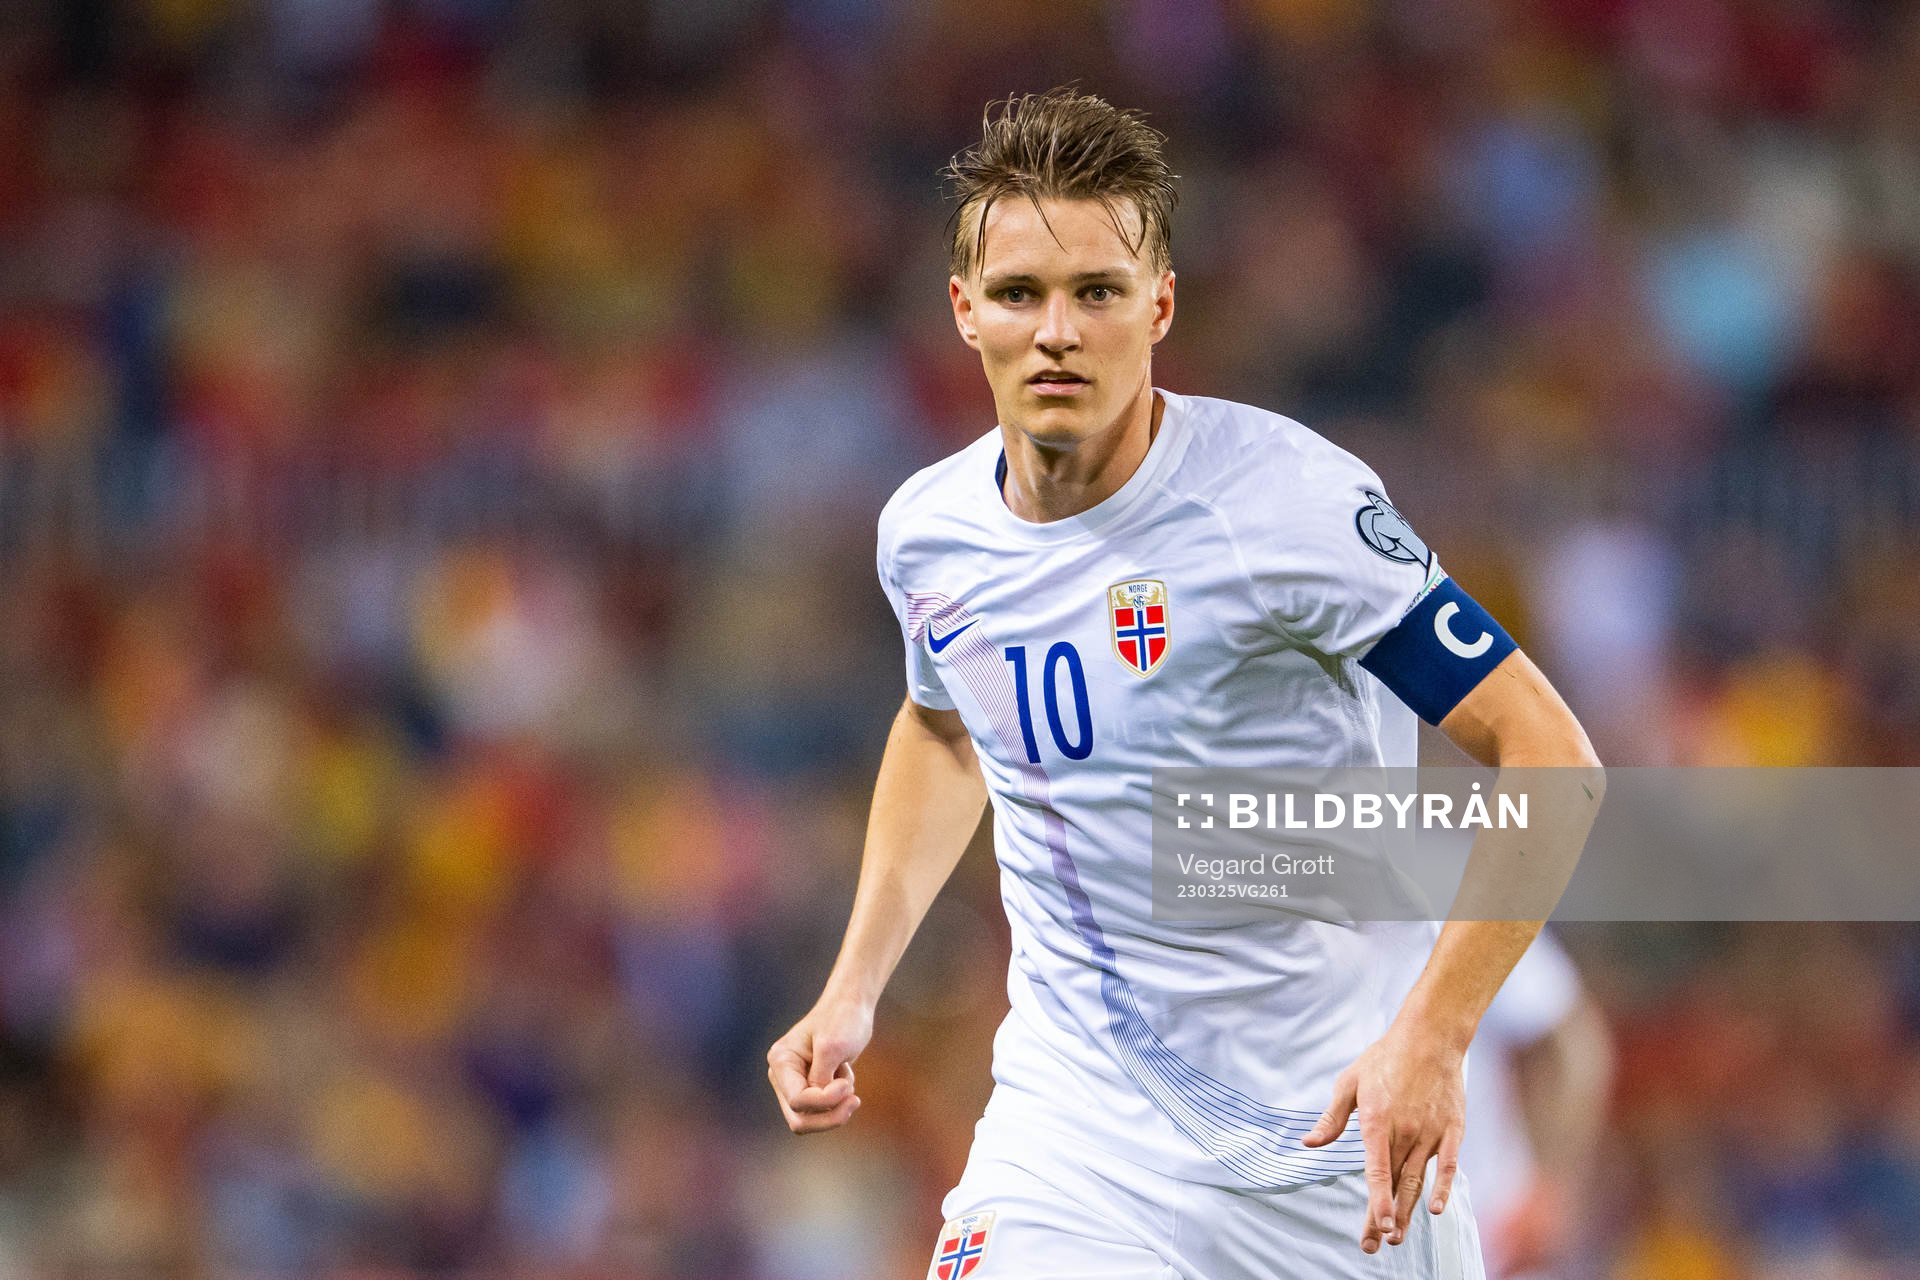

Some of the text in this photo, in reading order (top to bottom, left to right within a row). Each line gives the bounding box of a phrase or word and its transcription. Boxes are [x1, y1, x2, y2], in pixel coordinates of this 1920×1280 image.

[1128, 584, 1148, 593] NORGE
[1434, 602, 1494, 658] C
[1005, 641, 1094, 764] 10
